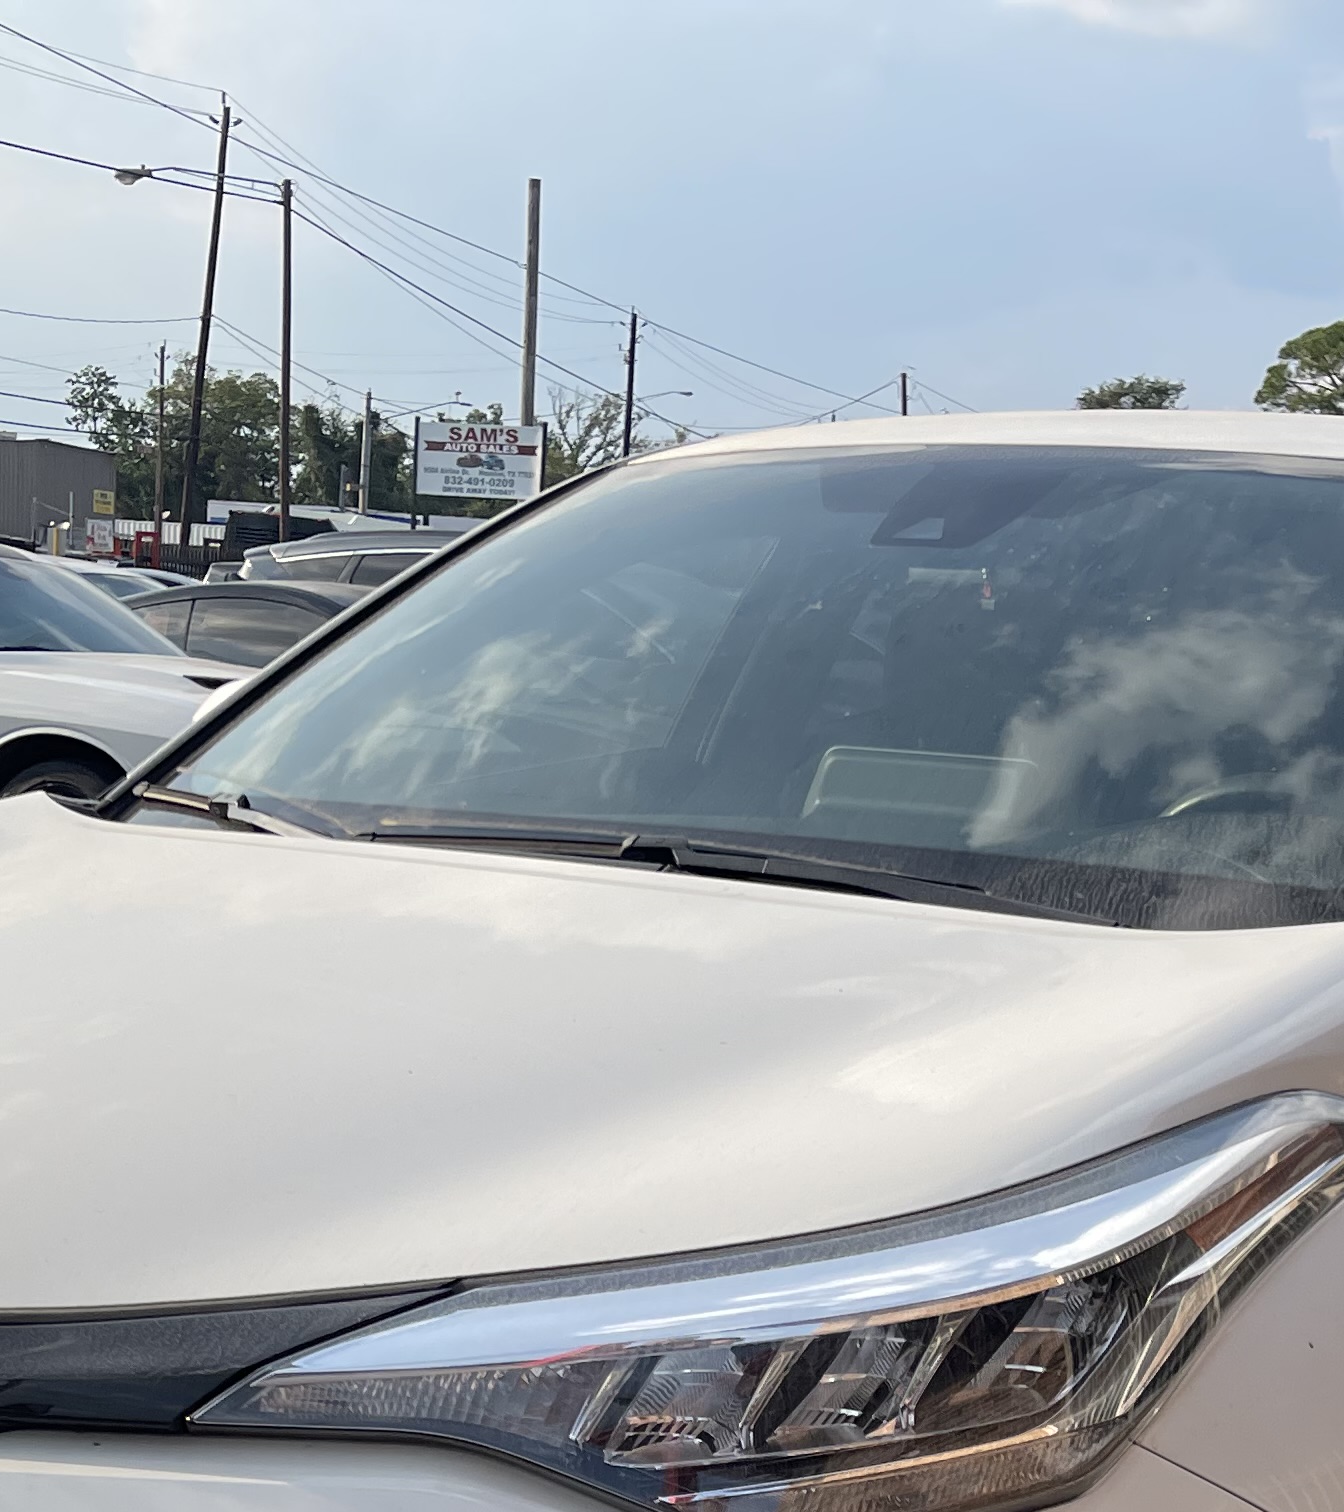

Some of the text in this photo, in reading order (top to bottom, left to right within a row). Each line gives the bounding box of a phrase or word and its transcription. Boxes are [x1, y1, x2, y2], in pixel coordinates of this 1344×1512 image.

[449, 427, 519, 443] SAM'S
[444, 443, 518, 454] AUTO SALES
[444, 476, 515, 488] 832-491-0209
